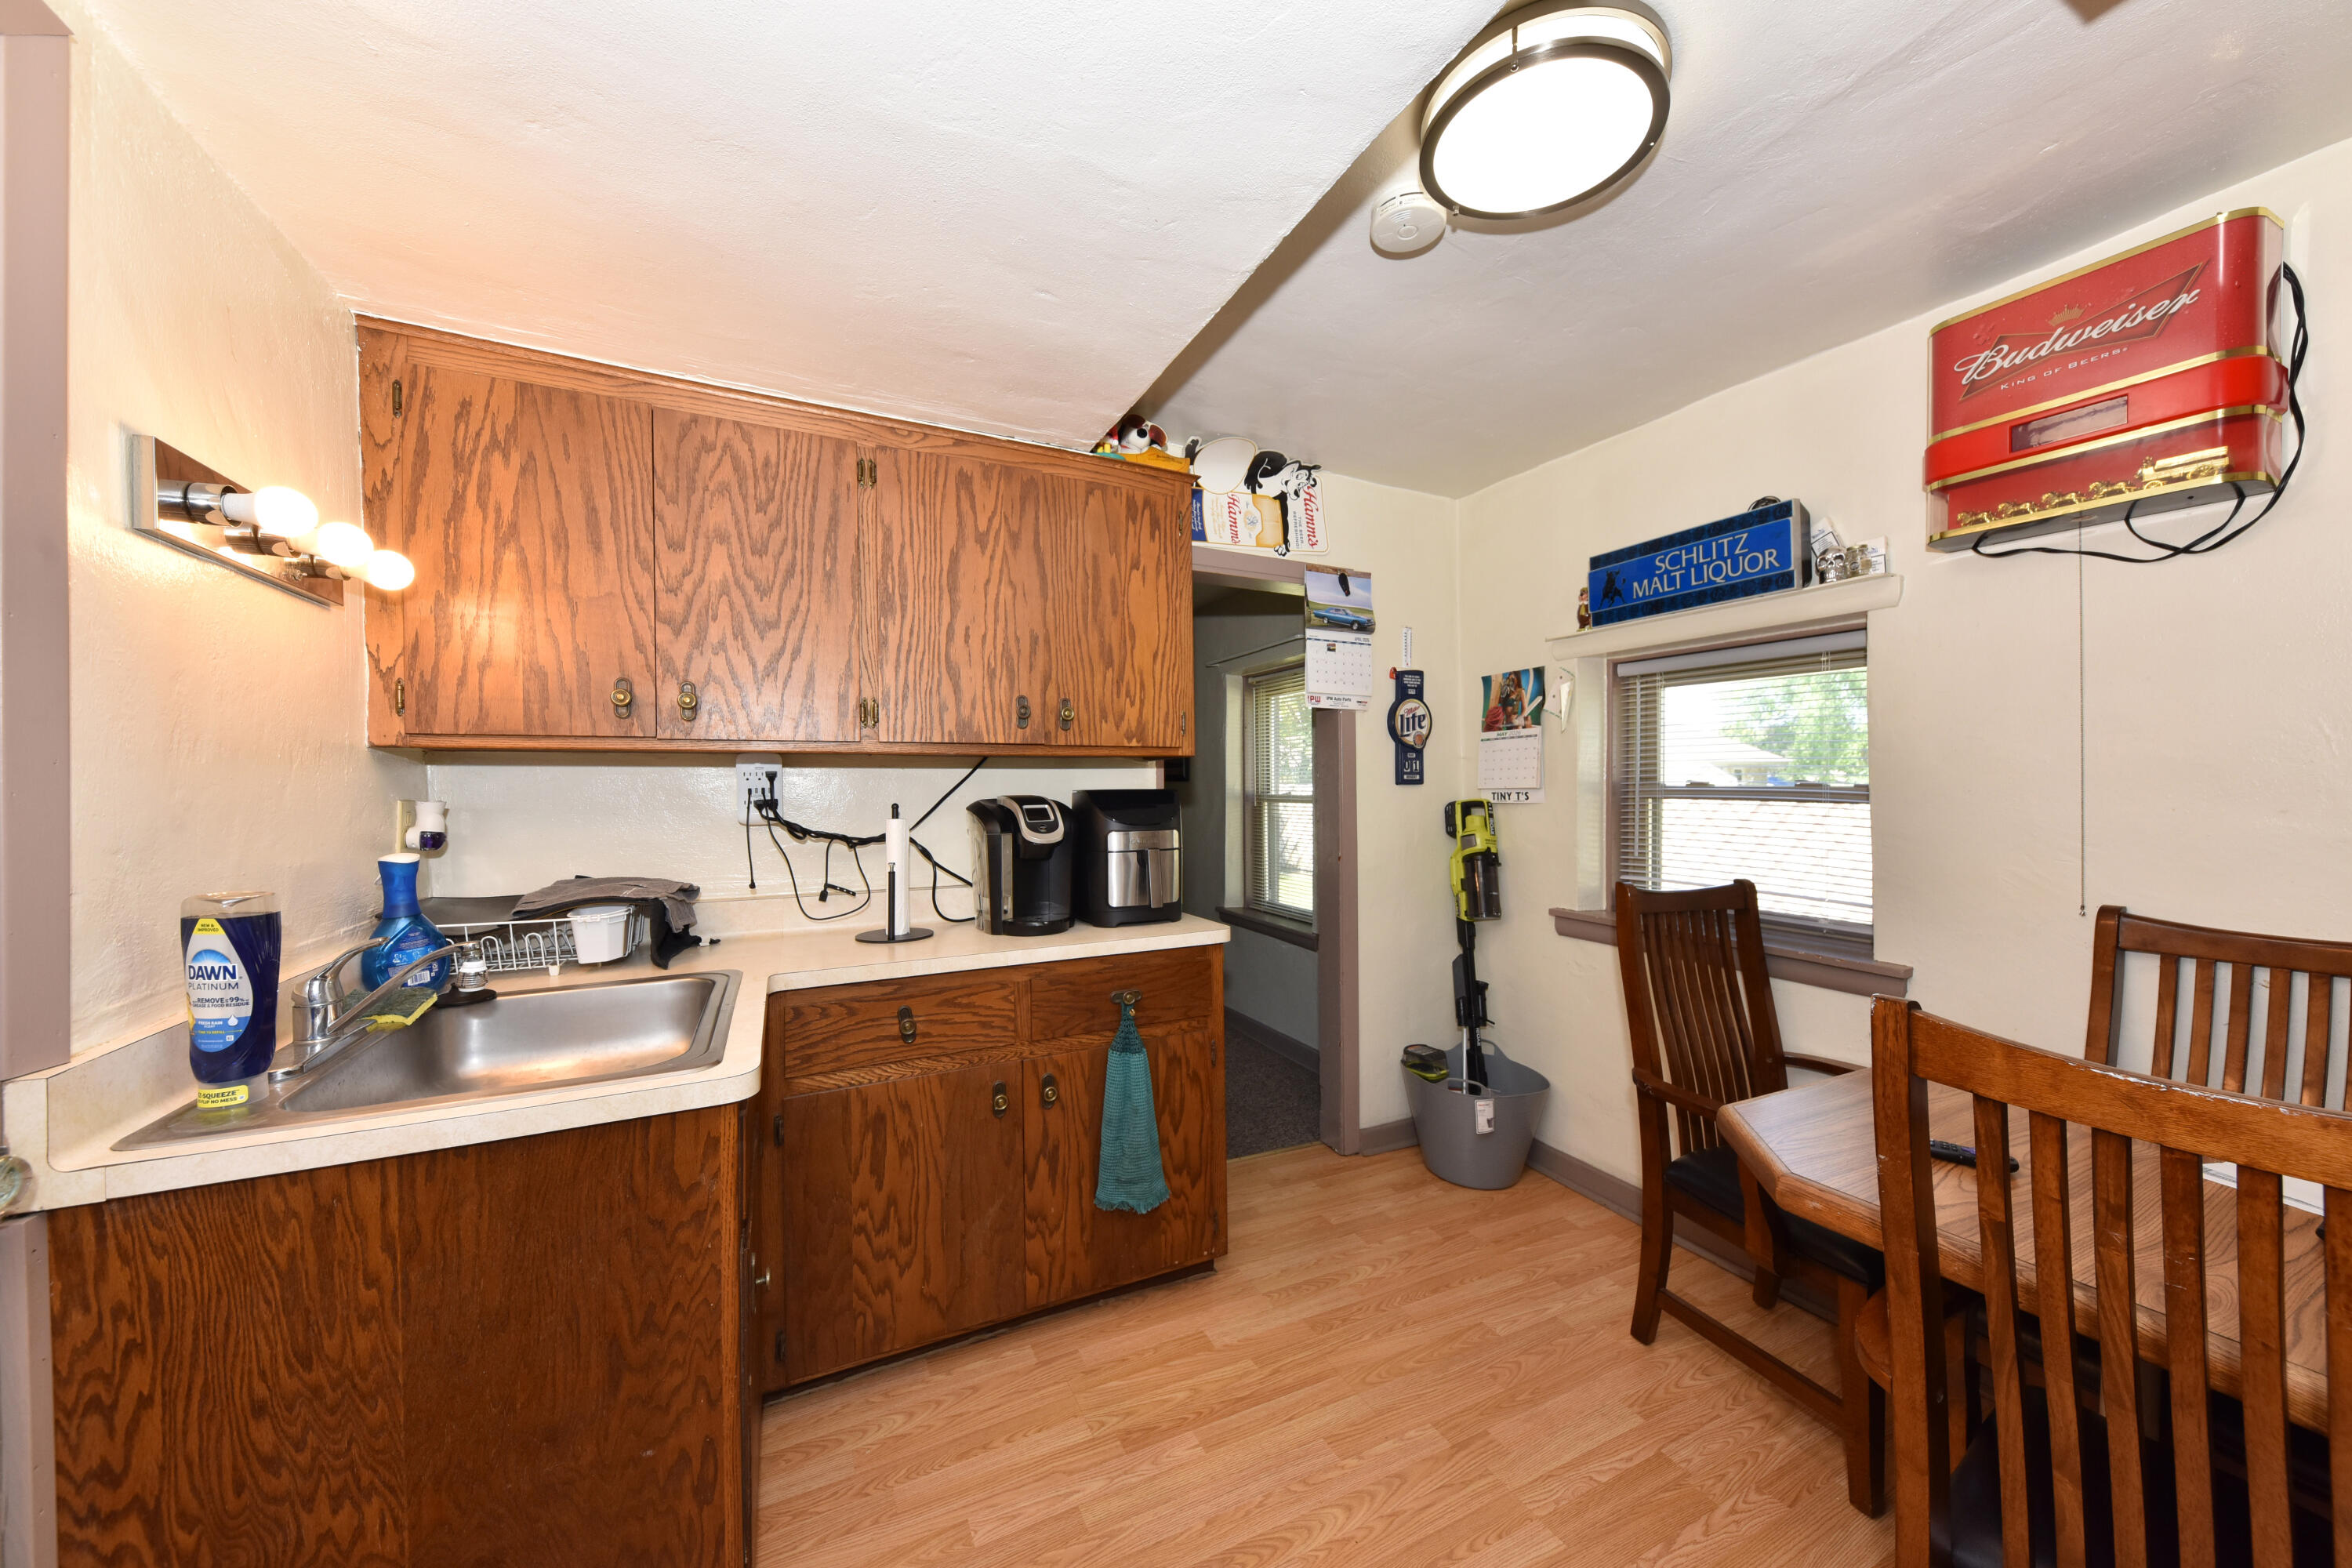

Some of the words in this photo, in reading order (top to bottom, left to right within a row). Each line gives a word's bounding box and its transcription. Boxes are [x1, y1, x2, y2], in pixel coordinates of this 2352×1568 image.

[1954, 289, 2201, 385] Budweiser
[2001, 376, 2036, 390] KING
[2043, 366, 2061, 377] OF
[2068, 348, 2122, 369] BEERS
[1227, 494, 1242, 545] Hamm's
[1303, 485, 1319, 549] Hamm's
[1632, 570, 1685, 599] MALT
[1691, 548, 1780, 586] LIQUOR
[1655, 532, 1749, 575] SCHLITZ
[1399, 713, 1426, 738] Lite
[1491, 791, 1512, 800] TINY
[1515, 791, 1530, 800] T'S
[188, 965, 237, 981] DAWN
[198, 1091, 236, 1100] Z-SQUEEZE
